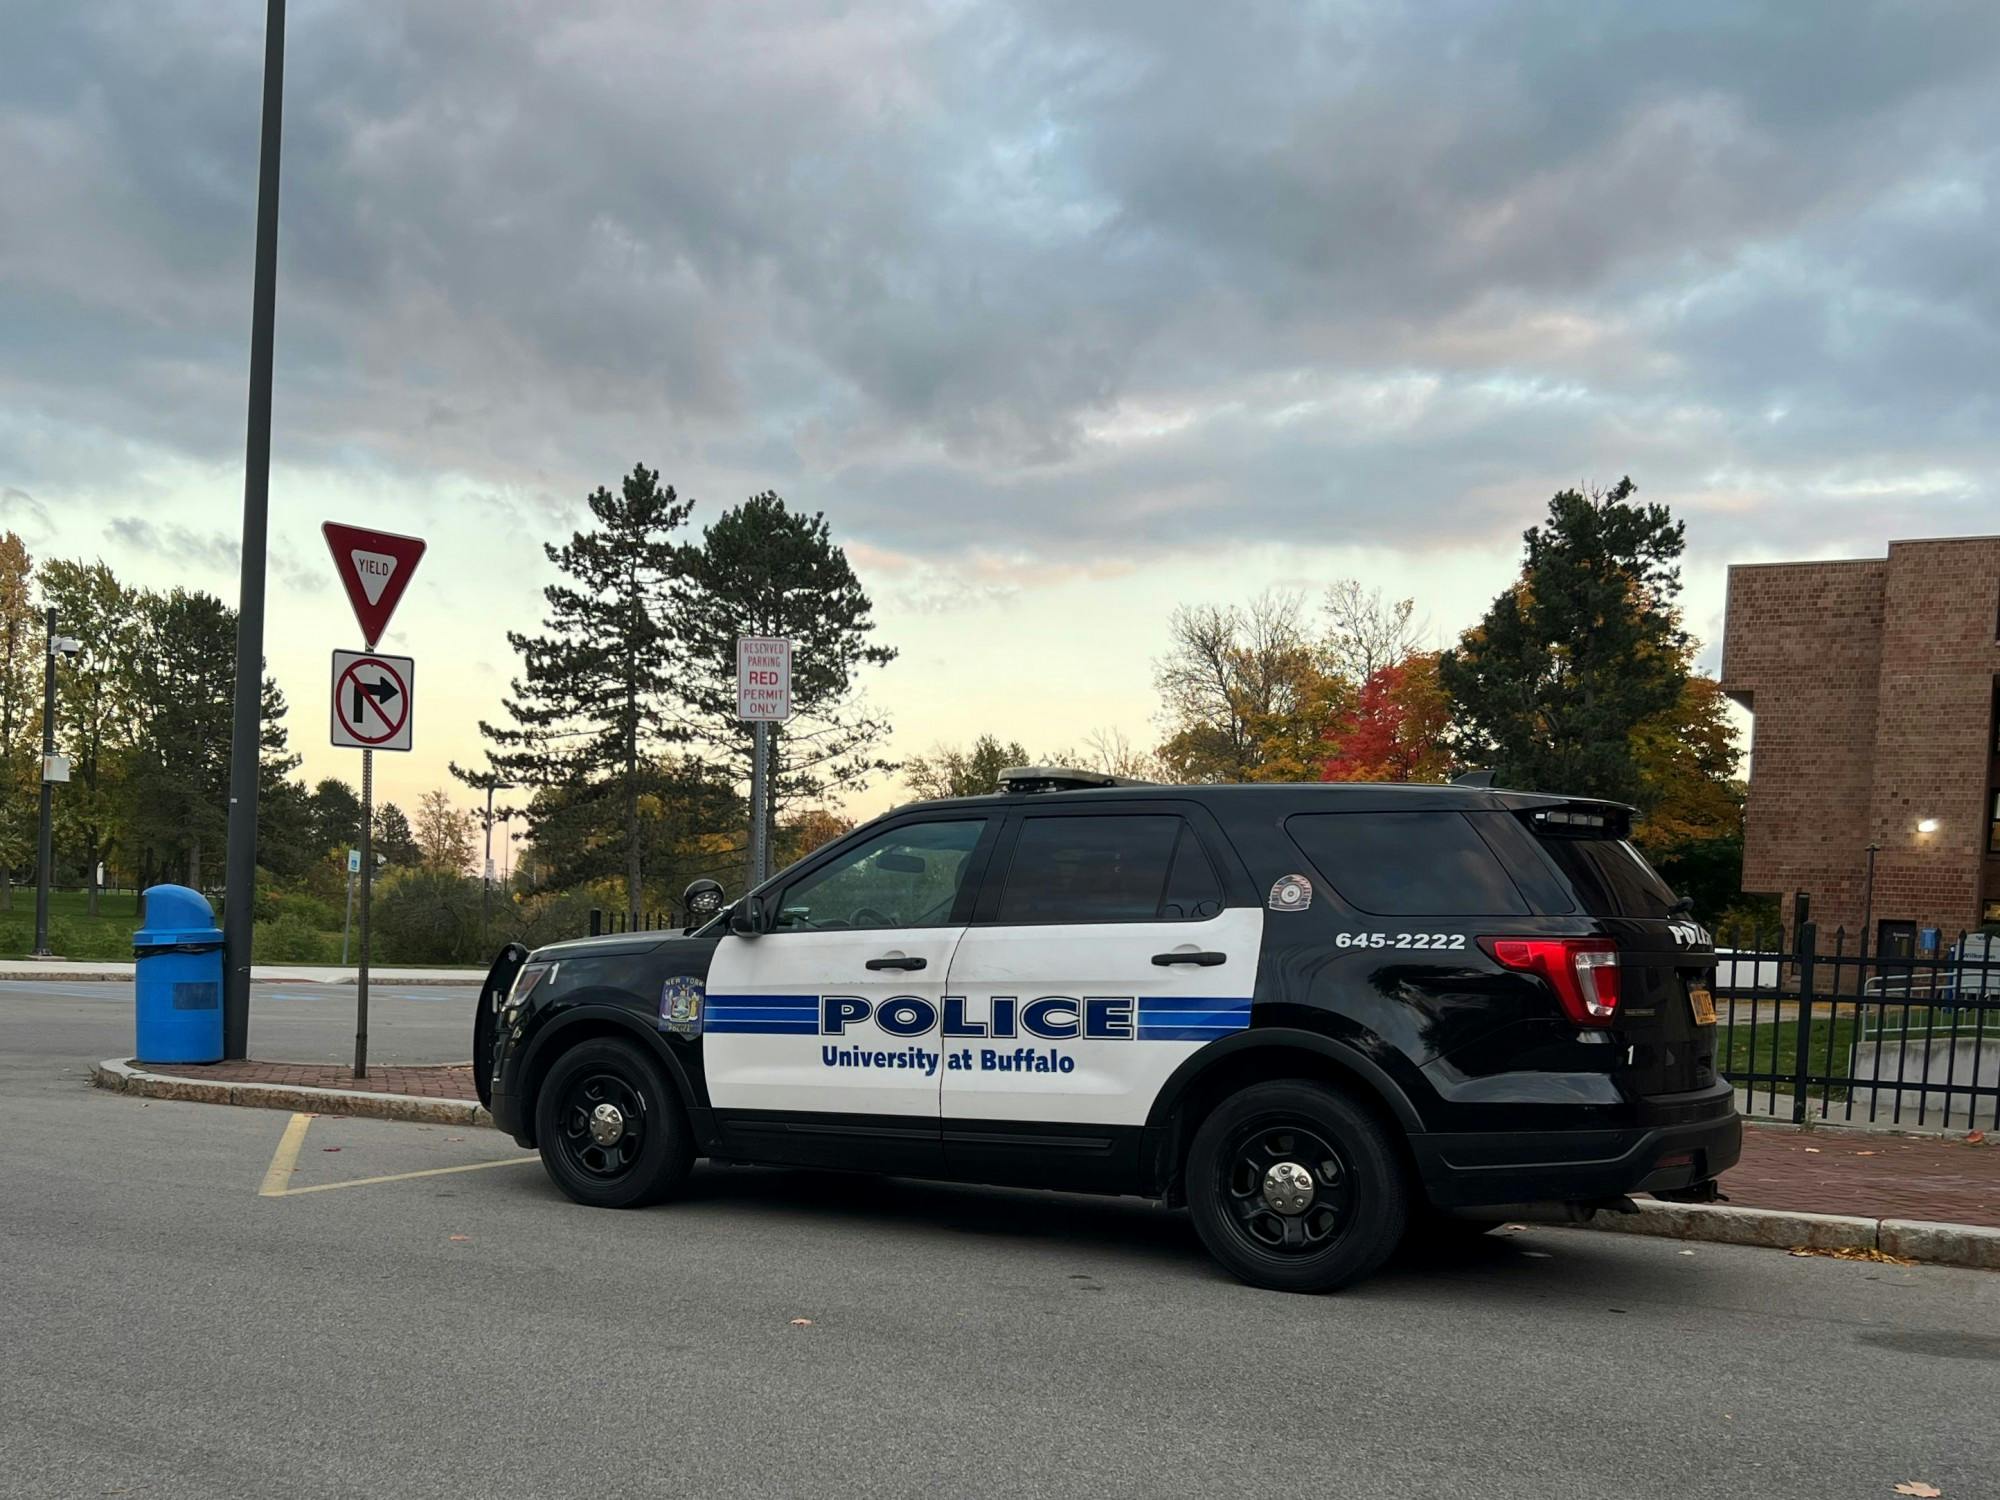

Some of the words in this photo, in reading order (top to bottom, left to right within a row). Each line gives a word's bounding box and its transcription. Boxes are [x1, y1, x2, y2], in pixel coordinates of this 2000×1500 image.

[358, 558, 389, 576] YIELD
[744, 643, 784, 654] RESERVED
[748, 656, 780, 667] PARKING
[749, 671, 778, 685] RED
[743, 689, 784, 699] PERMIT
[750, 703, 777, 713] ONLY
[1335, 932, 1466, 950] 645-2222
[549, 963, 560, 985] 1
[686, 977, 705, 987] YORK
[821, 995, 1135, 1041] POLICE
[822, 1045, 940, 1076] University
[947, 1049, 972, 1070] at
[981, 1048, 1075, 1073] Buffalo
[1627, 1045, 1634, 1065] 1
